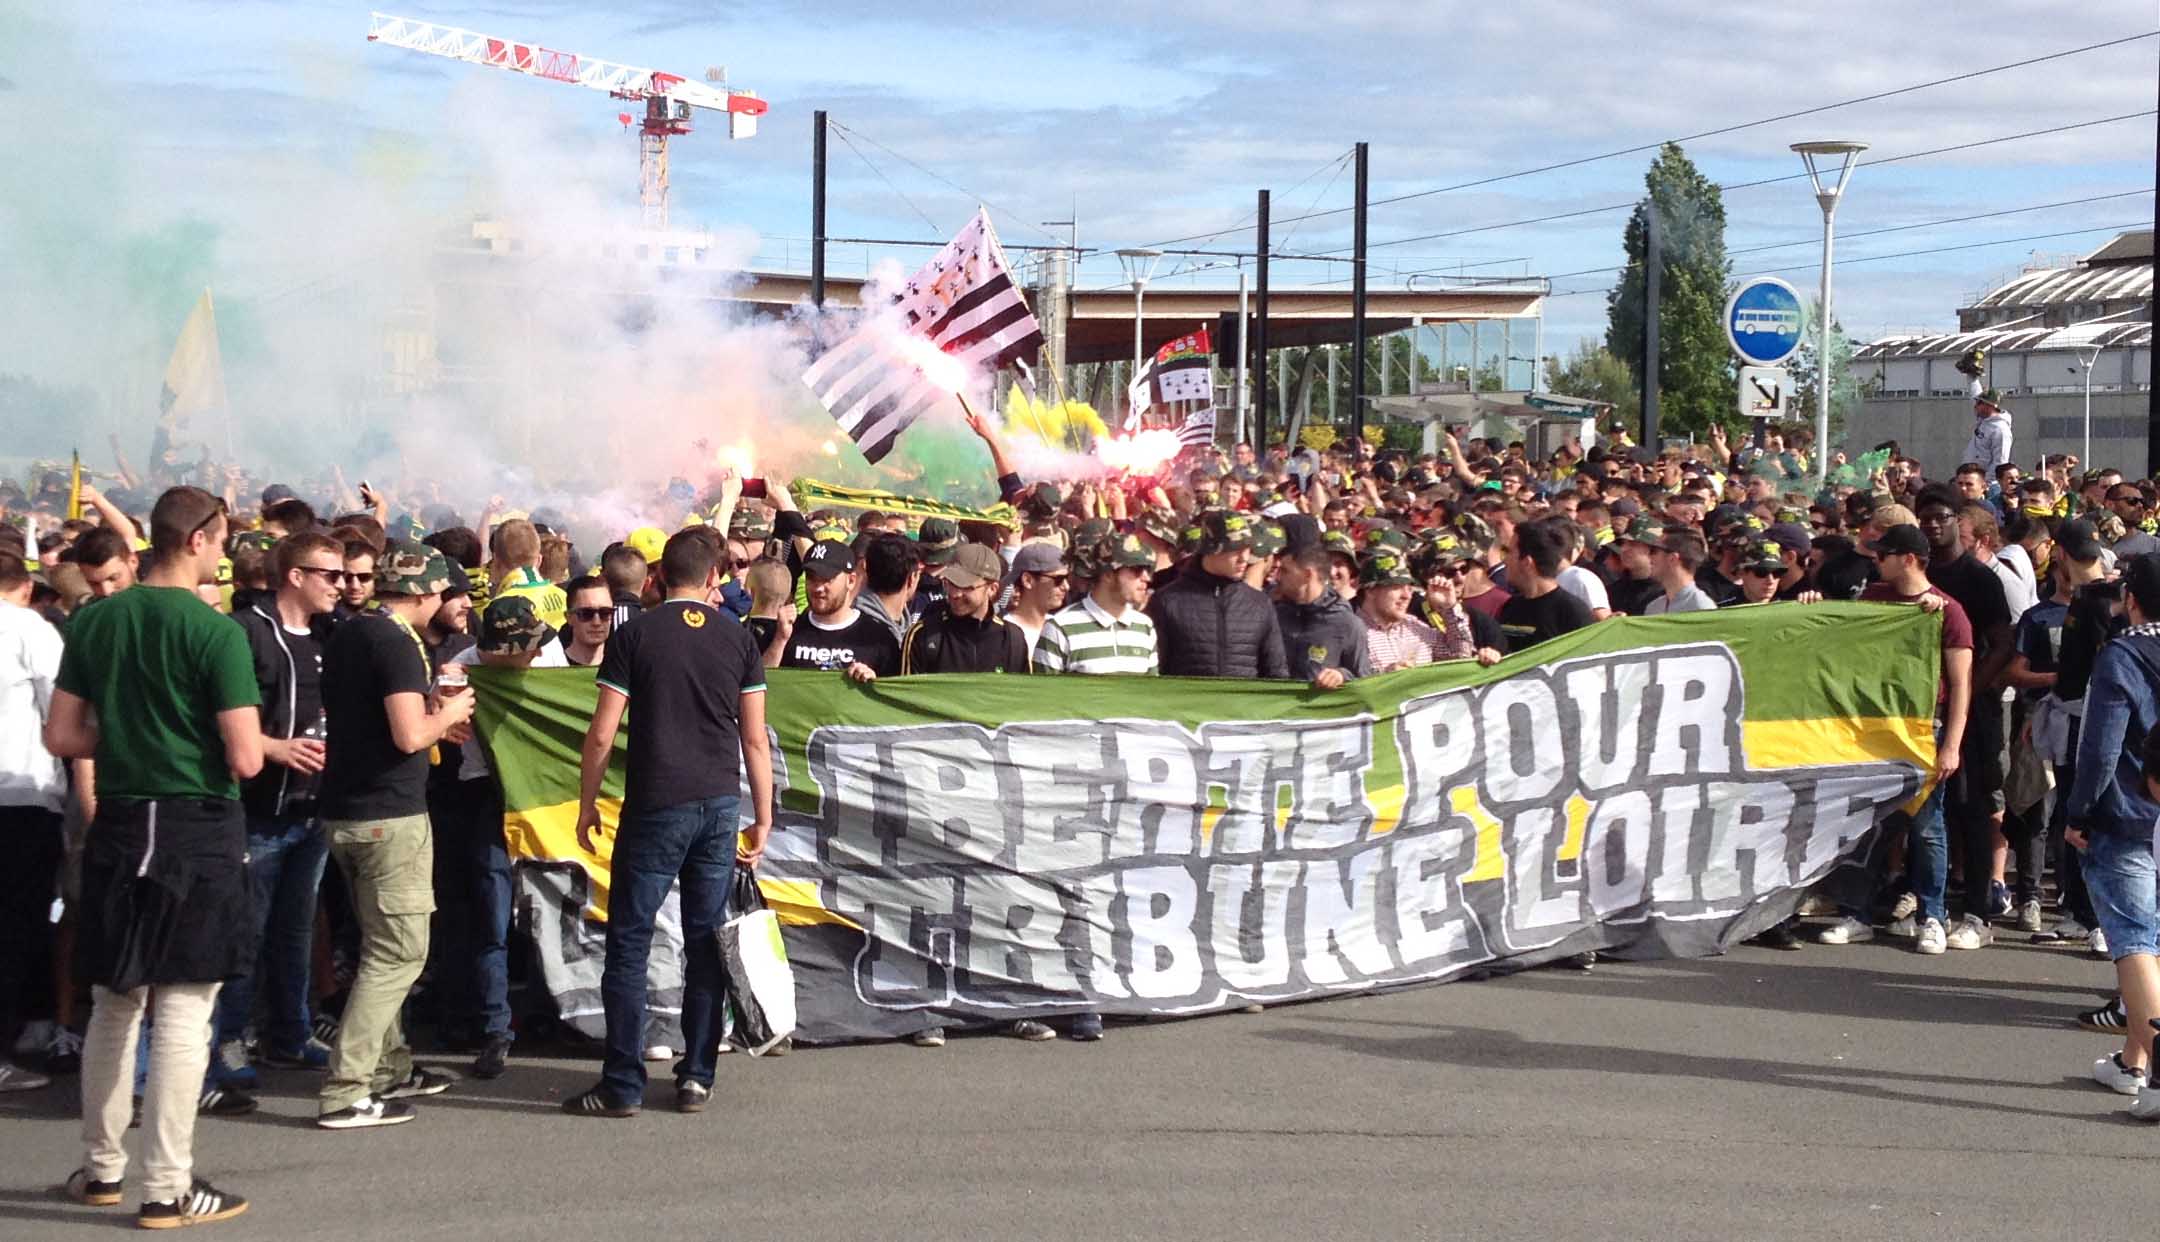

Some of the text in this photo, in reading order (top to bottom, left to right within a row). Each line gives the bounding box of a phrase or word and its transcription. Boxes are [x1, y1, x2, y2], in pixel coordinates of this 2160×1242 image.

[811, 544, 827, 560] NY
[741, 655, 1732, 872] IBERTE POUR
[836, 828, 1440, 998] TRIBUNE
